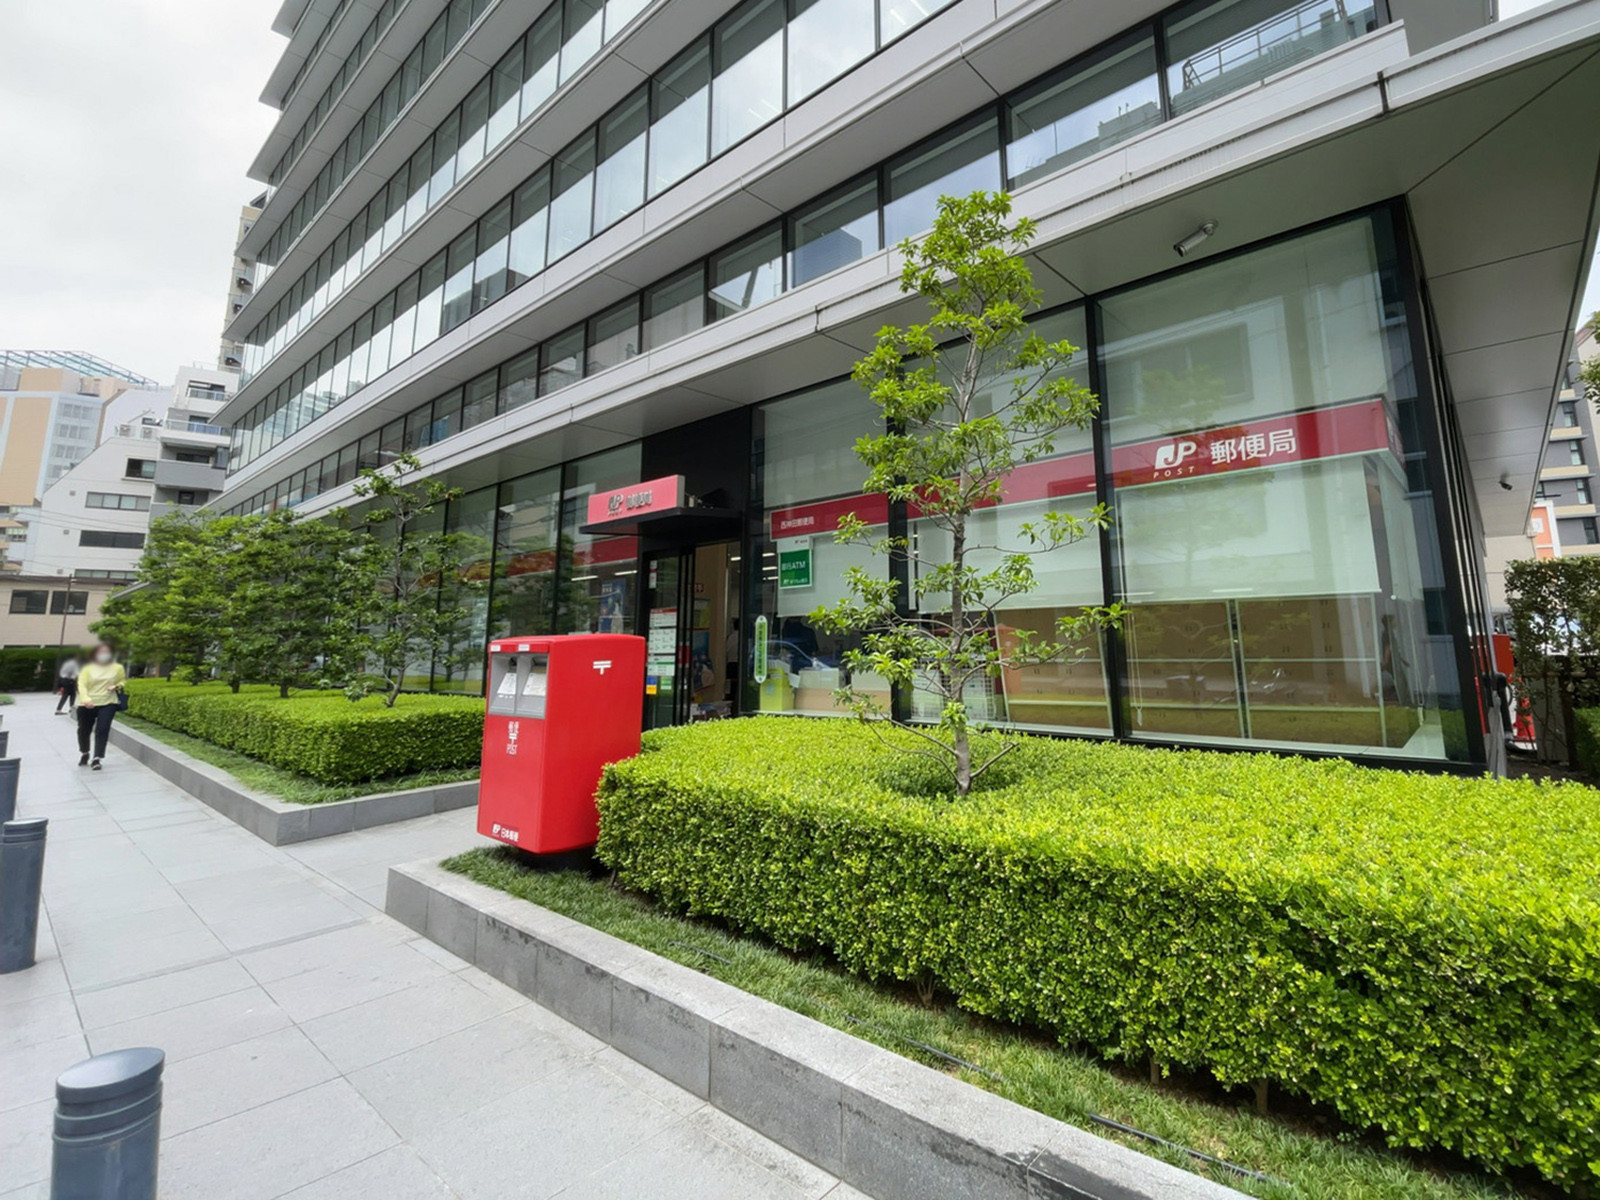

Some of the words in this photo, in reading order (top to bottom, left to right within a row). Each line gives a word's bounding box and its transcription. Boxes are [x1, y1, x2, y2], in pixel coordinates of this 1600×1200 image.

[1154, 441, 1197, 470] JP
[1210, 428, 1297, 465] 郵便局
[1153, 466, 1195, 479] POST
